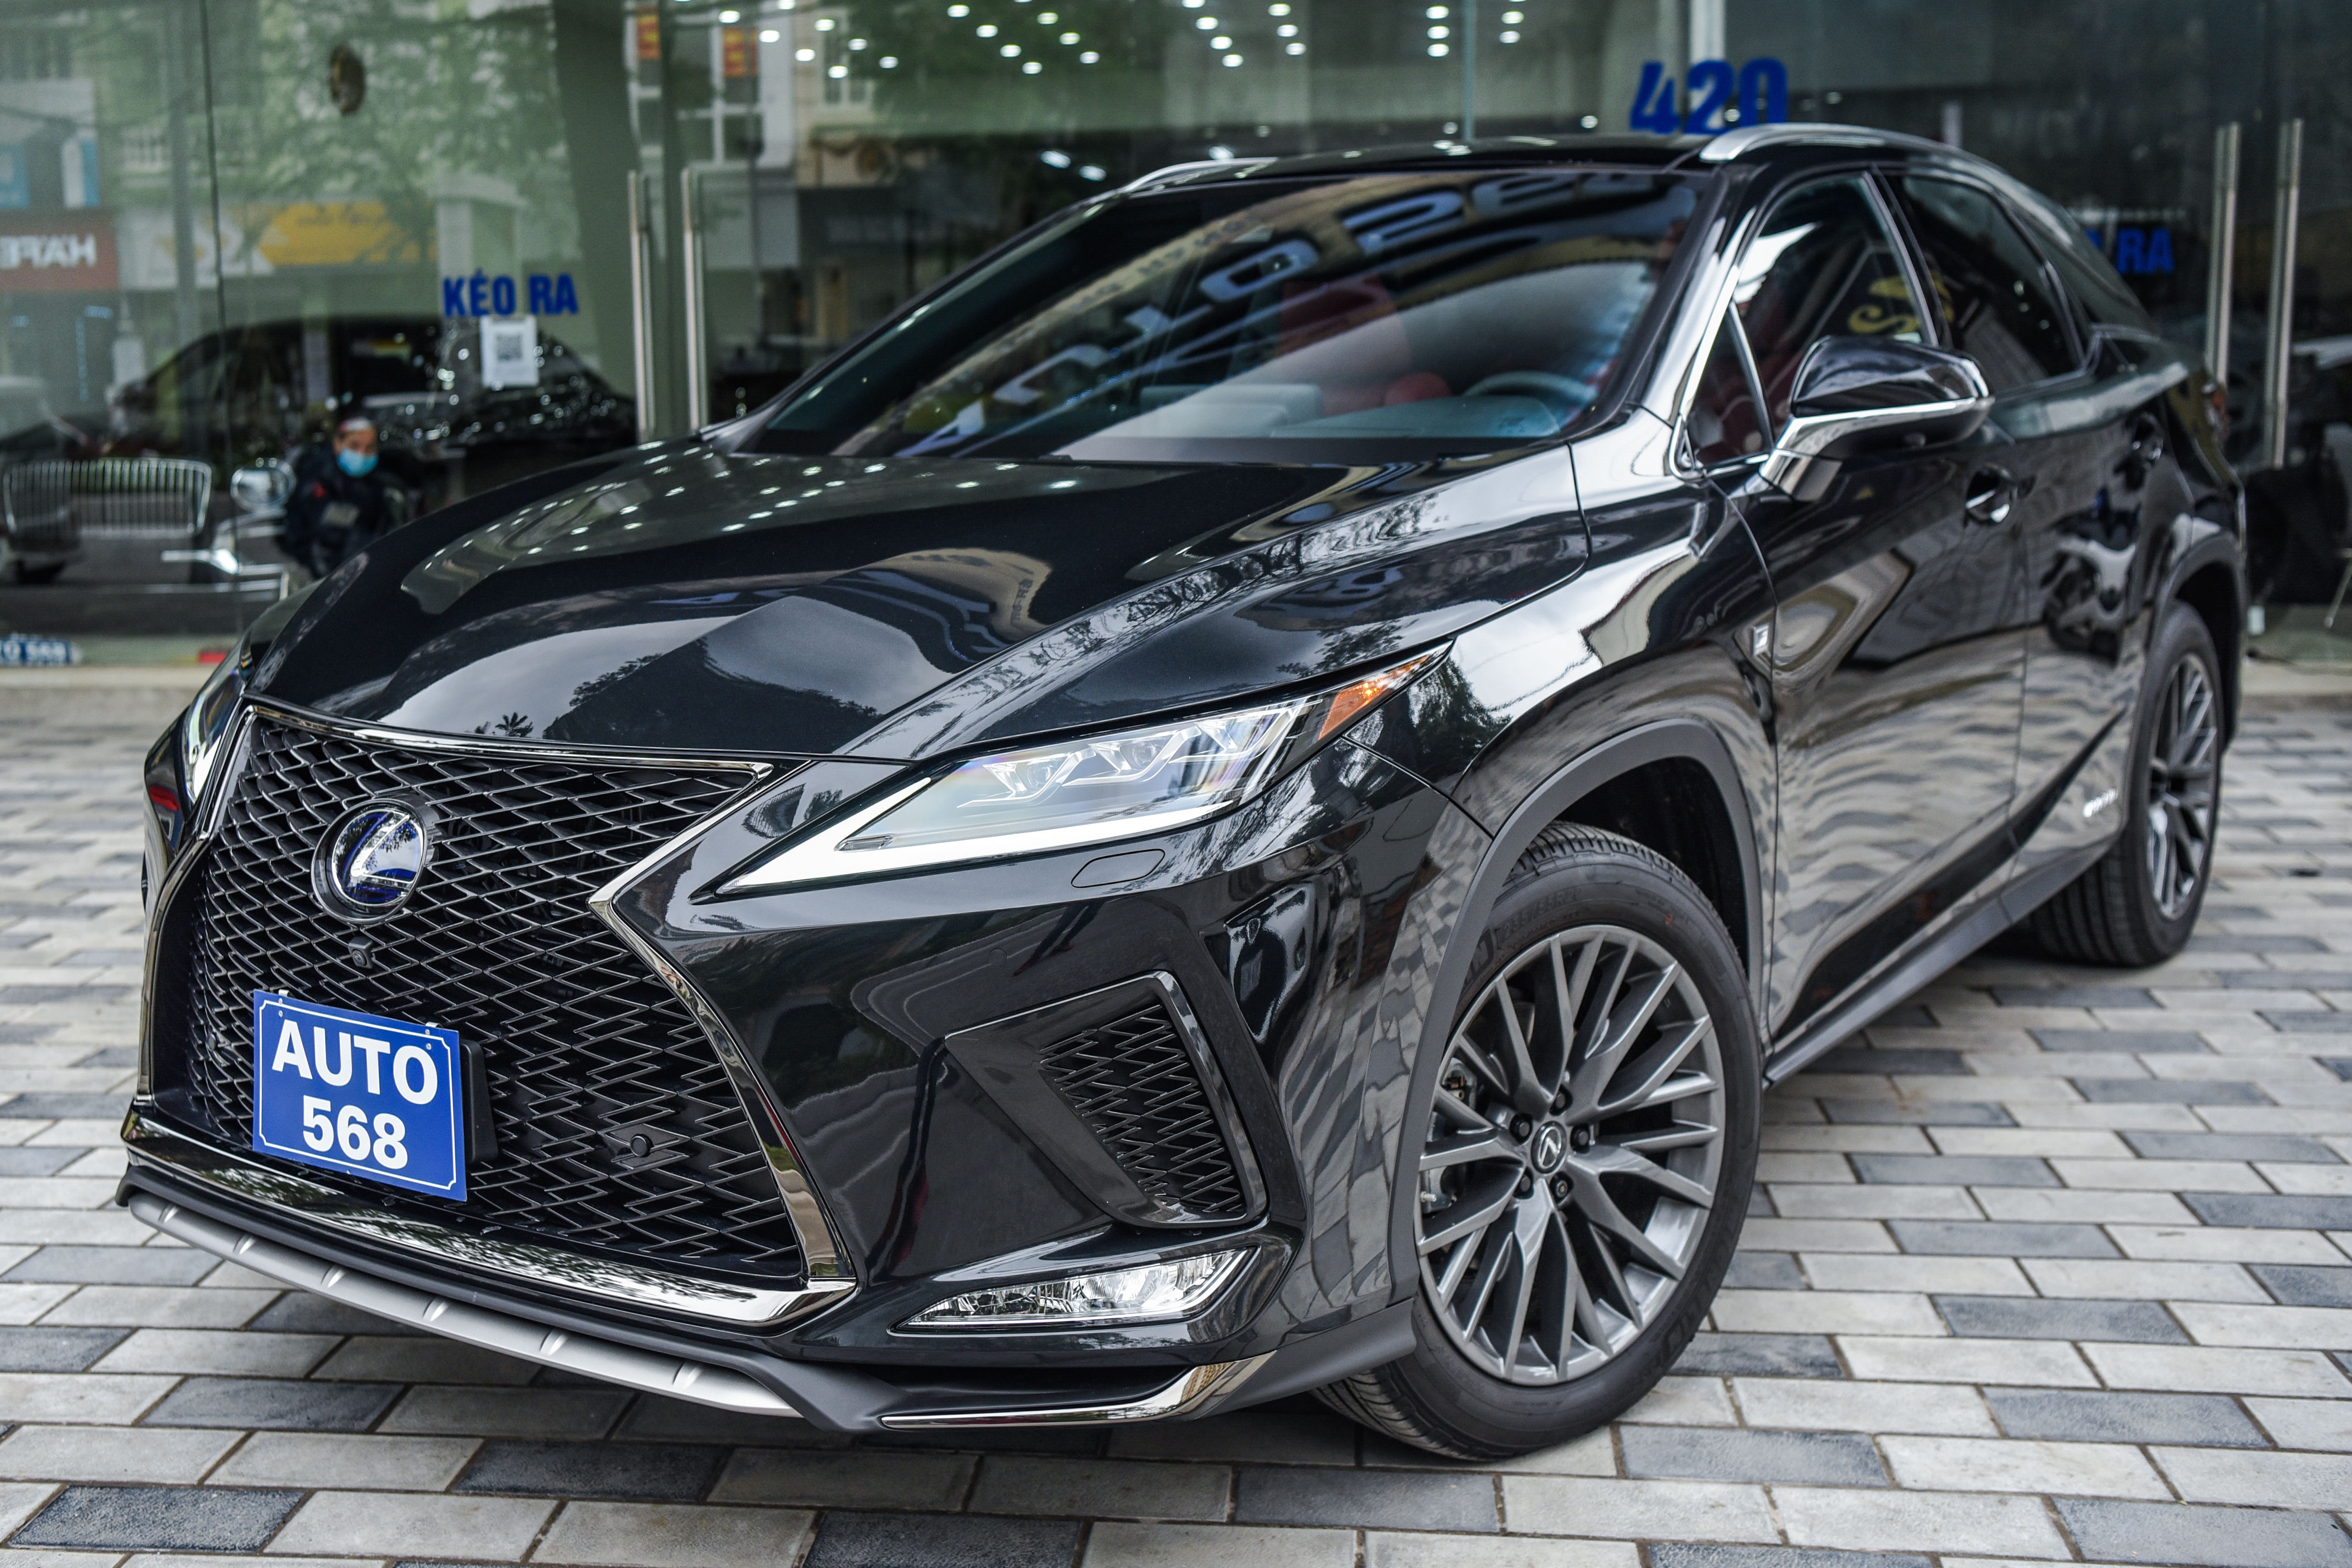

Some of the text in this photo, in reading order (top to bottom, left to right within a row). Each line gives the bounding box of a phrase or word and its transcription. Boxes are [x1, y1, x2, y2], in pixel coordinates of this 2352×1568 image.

[1630, 58, 1788, 134] 420
[2117, 227, 2174, 274] RA
[443, 267, 578, 317] KÉO RA
[272, 1019, 438, 1105] AUTO
[303, 1094, 408, 1169] 568
